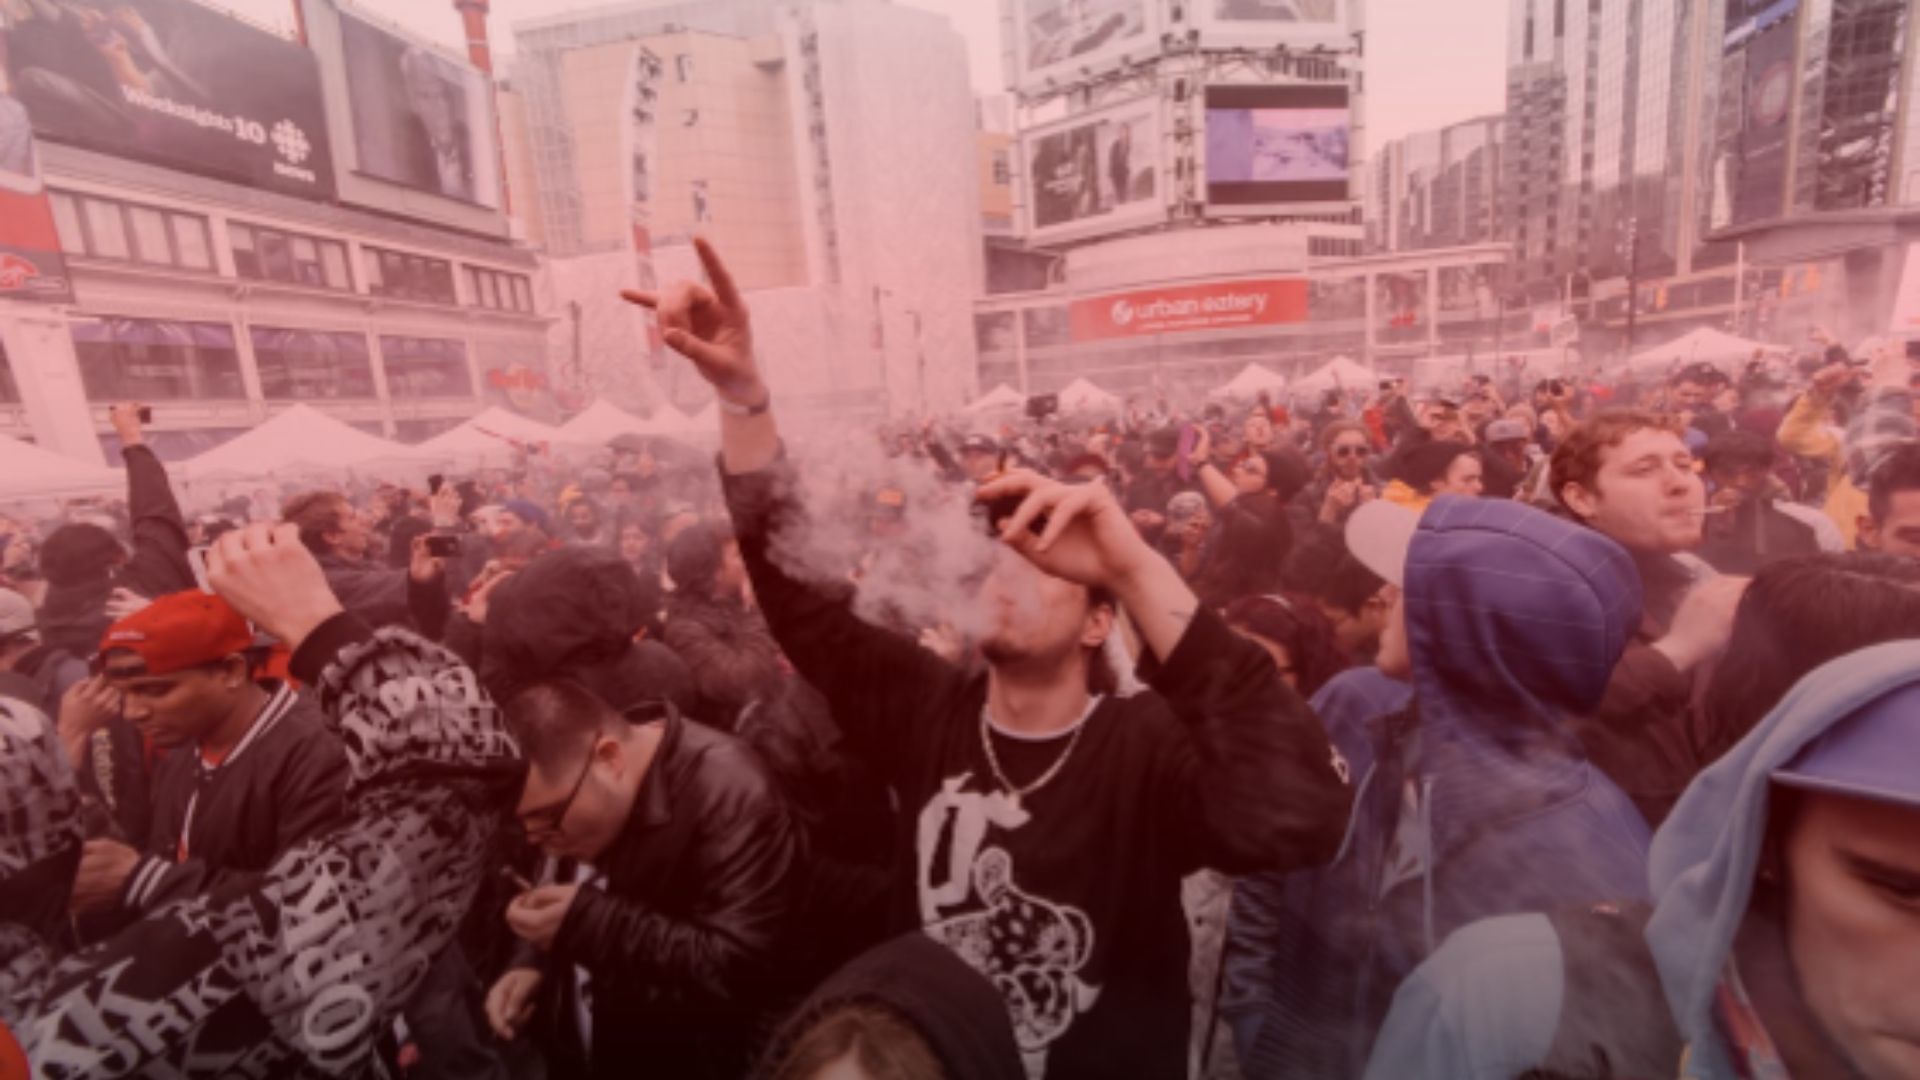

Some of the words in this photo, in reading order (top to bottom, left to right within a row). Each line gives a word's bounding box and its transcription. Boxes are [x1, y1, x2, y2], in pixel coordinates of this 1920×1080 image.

[233, 114, 267, 145] 10
[1137, 298, 1200, 318] urban
[1203, 292, 1269, 315] eatery
